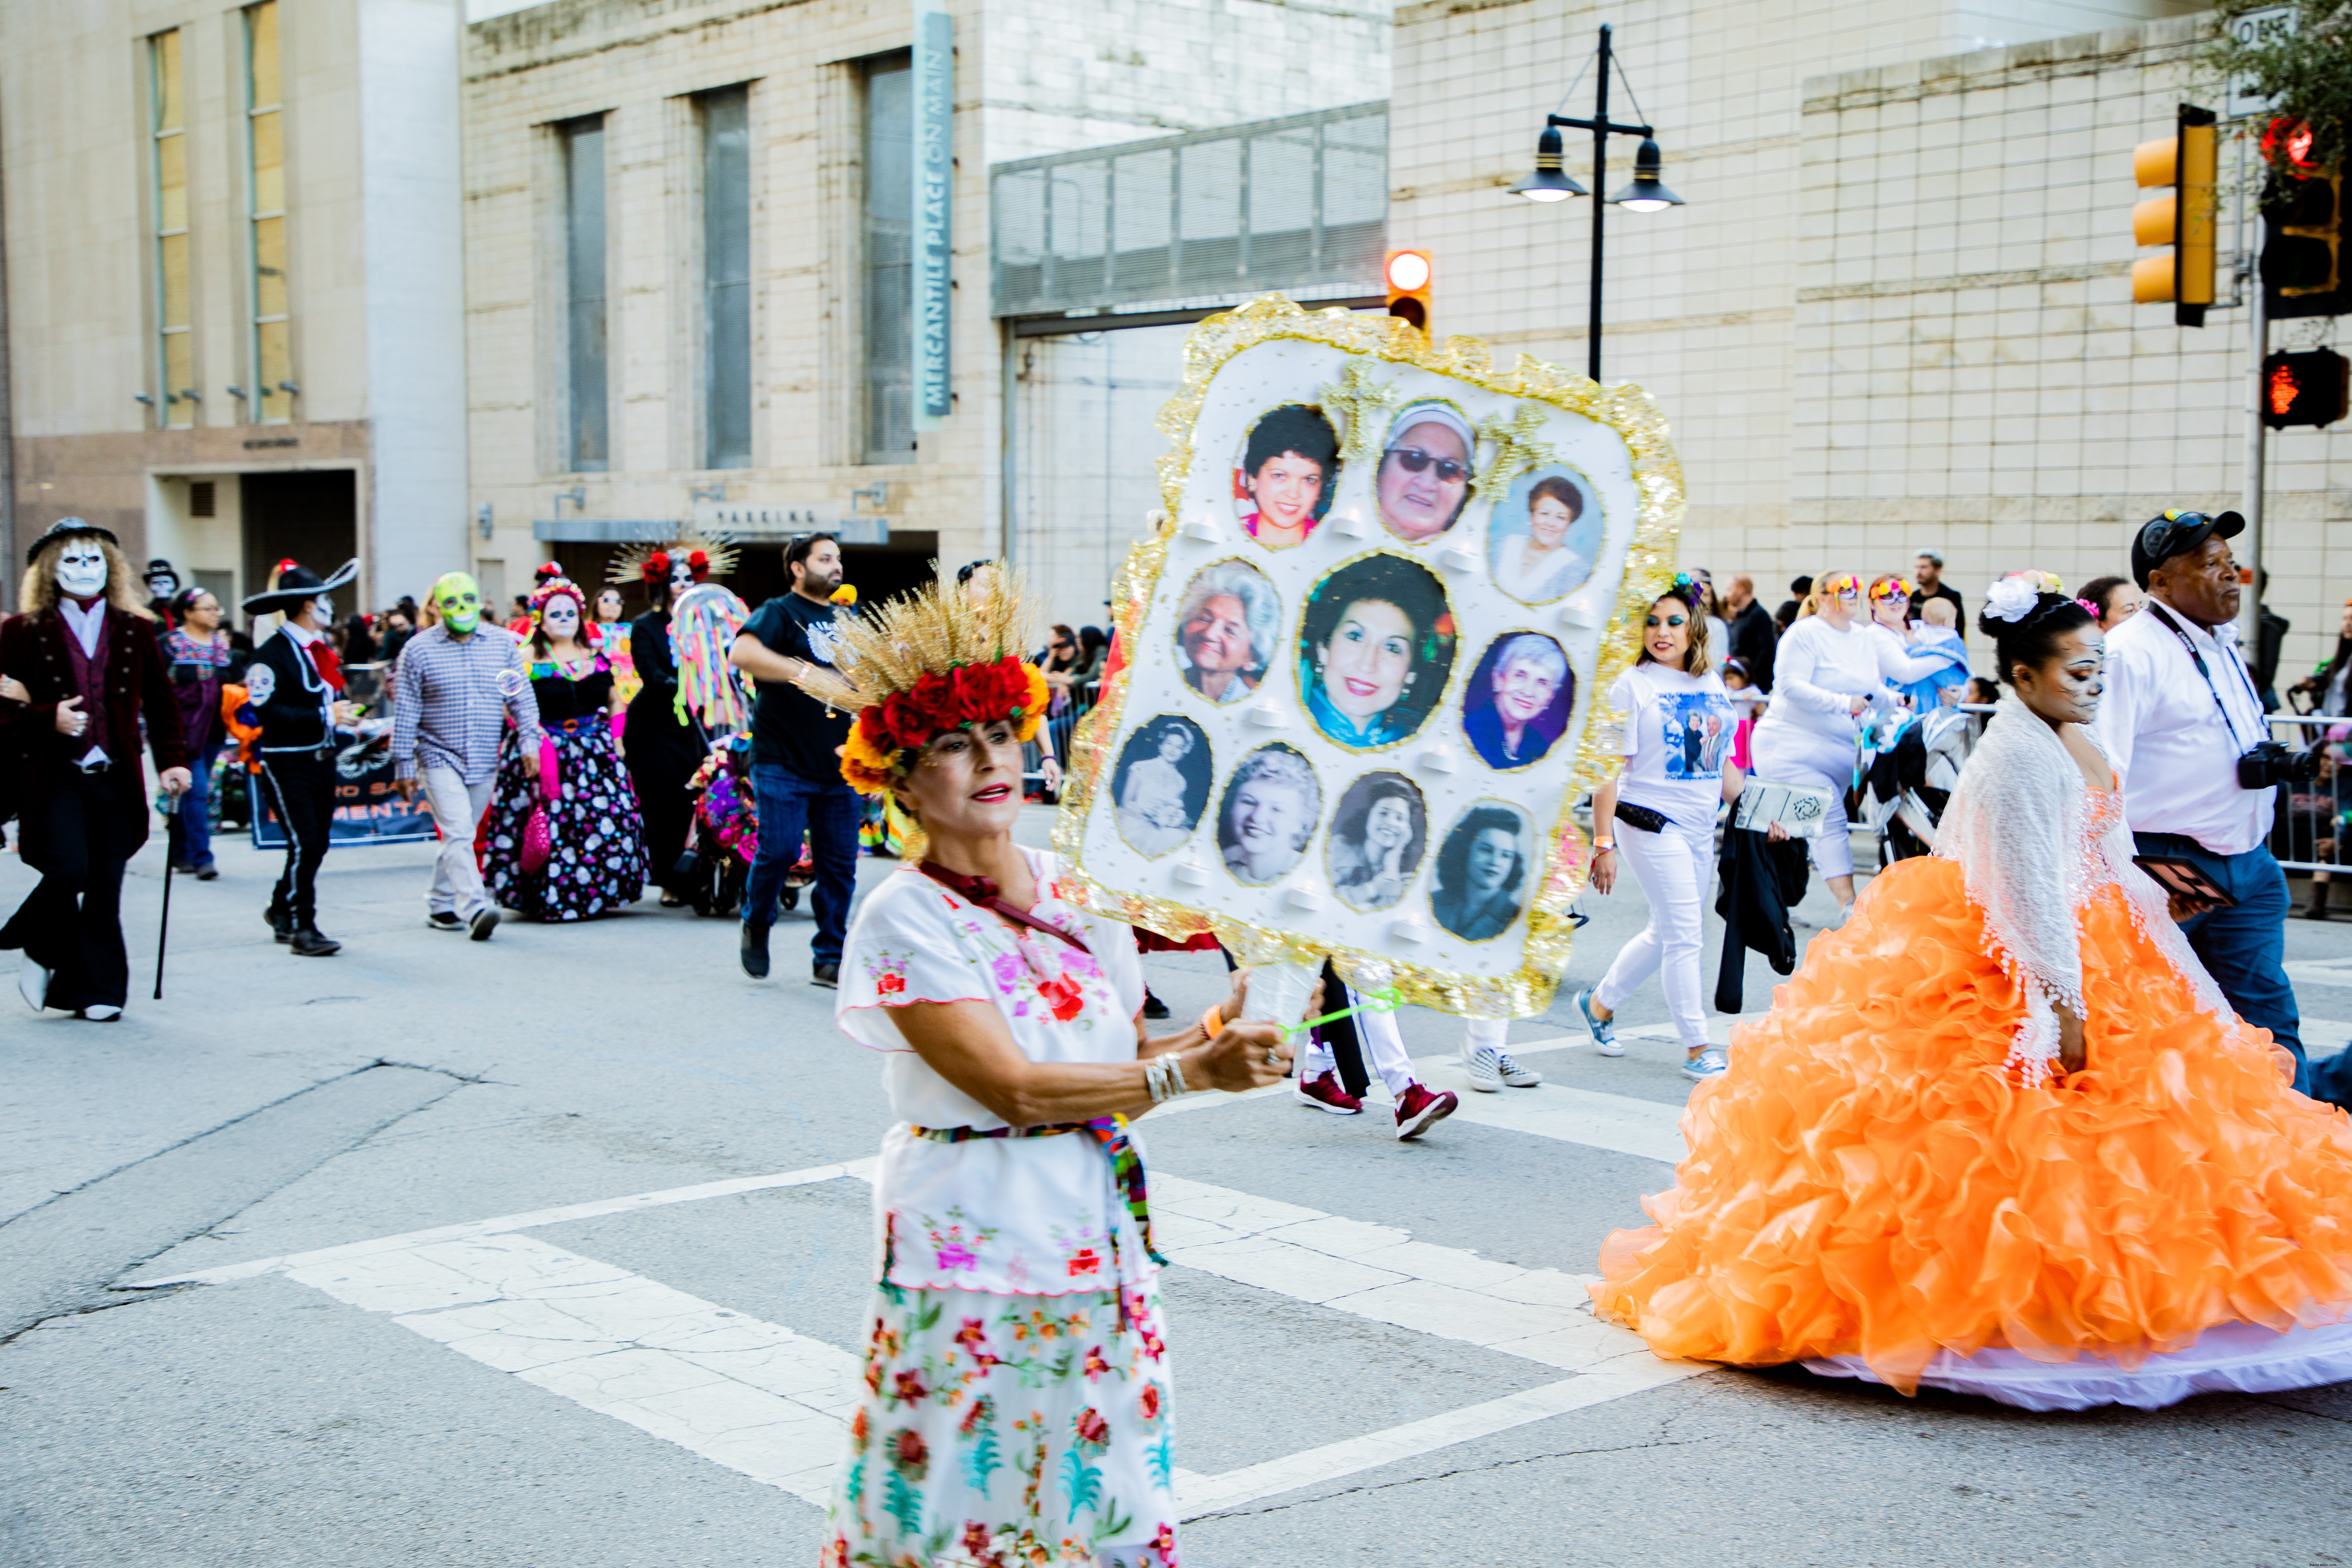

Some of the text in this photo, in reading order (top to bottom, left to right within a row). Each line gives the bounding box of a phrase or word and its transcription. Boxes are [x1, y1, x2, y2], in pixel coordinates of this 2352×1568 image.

[926, 49, 944, 407] MERCANTILE PLACE ON MAIN
[717, 510, 814, 524] PARKING
